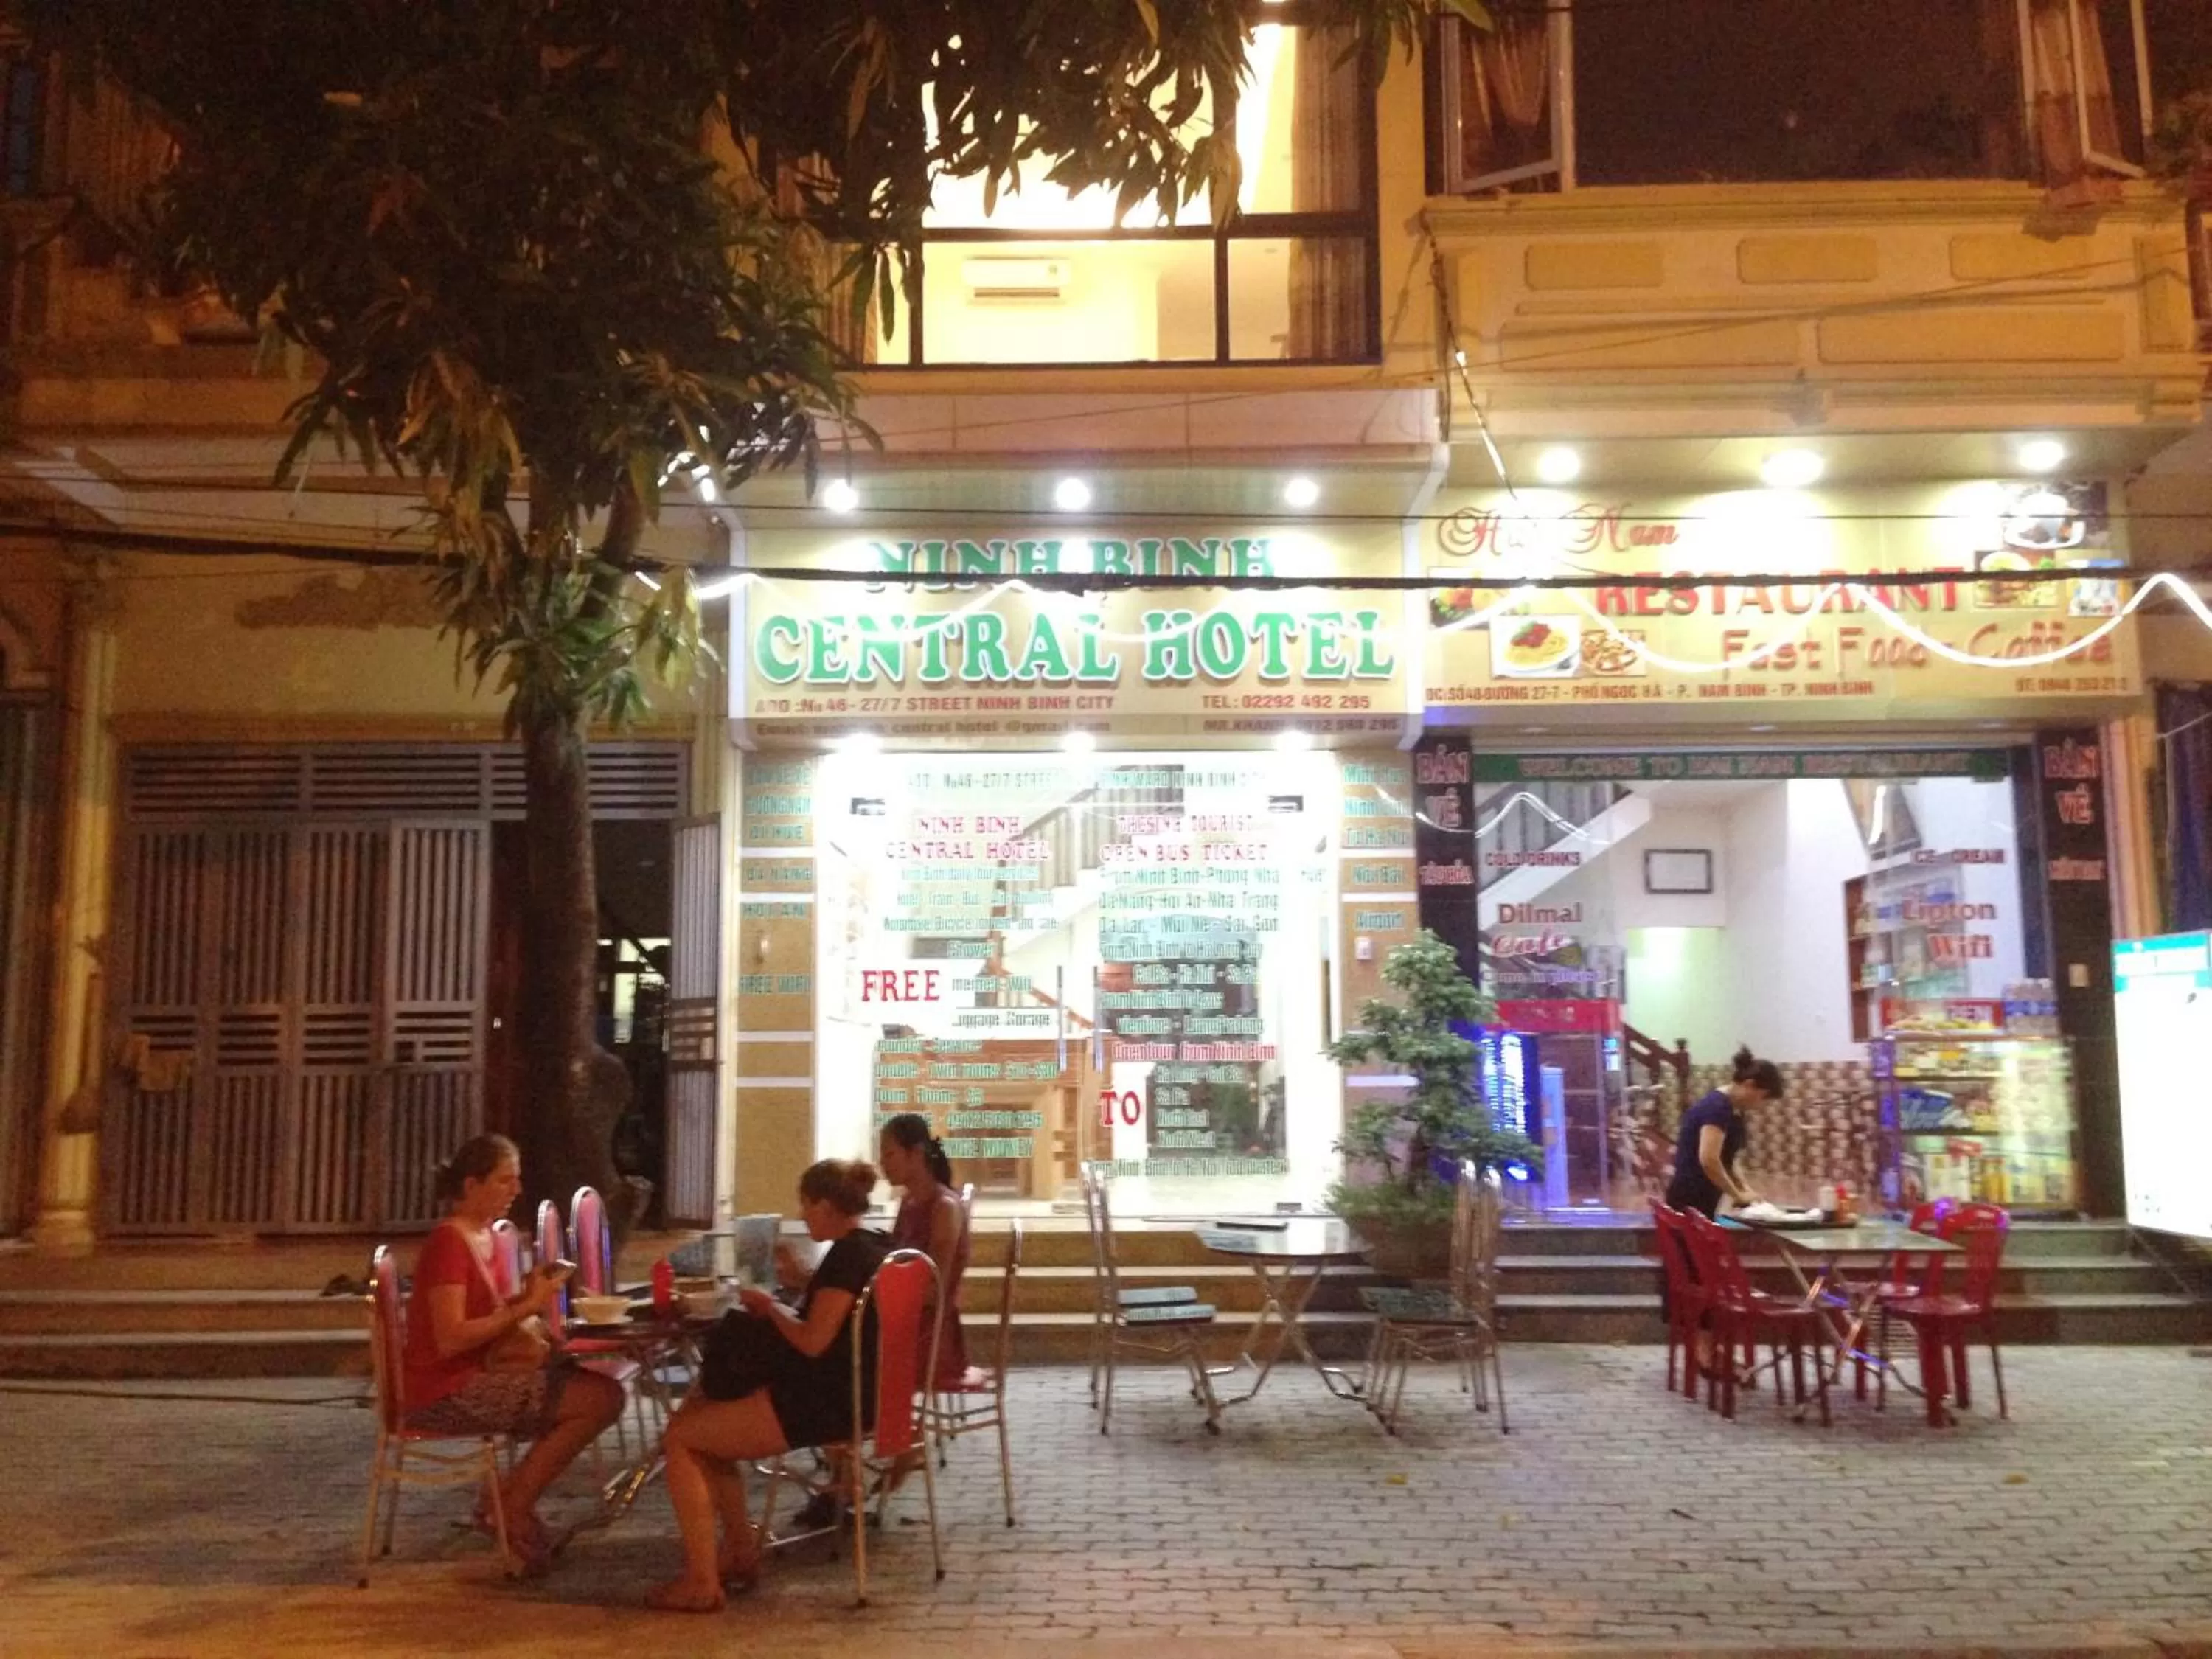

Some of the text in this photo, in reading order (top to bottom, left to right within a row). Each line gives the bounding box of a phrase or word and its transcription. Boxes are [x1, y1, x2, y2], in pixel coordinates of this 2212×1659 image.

[866, 540, 1277, 592] NINH BINH
[1595, 566, 1964, 616] RESTAURANT
[755, 611, 1395, 684] CENTRAL HOTEL
[1722, 628, 1821, 675] Fast
[906, 696, 971, 711] STREET
[975, 695, 1021, 710] NINH
[1027, 695, 1071, 709] BINH
[1076, 695, 1114, 709] CITY
[1339, 695, 1370, 709] 295
[886, 841, 1050, 860] CENTRAL HOTEL
[1099, 844, 1268, 862] OPEN BUS TICKET
[1927, 933, 1994, 959] Wifi
[860, 970, 940, 1002] FREE
[1099, 1090, 1141, 1126] TO
